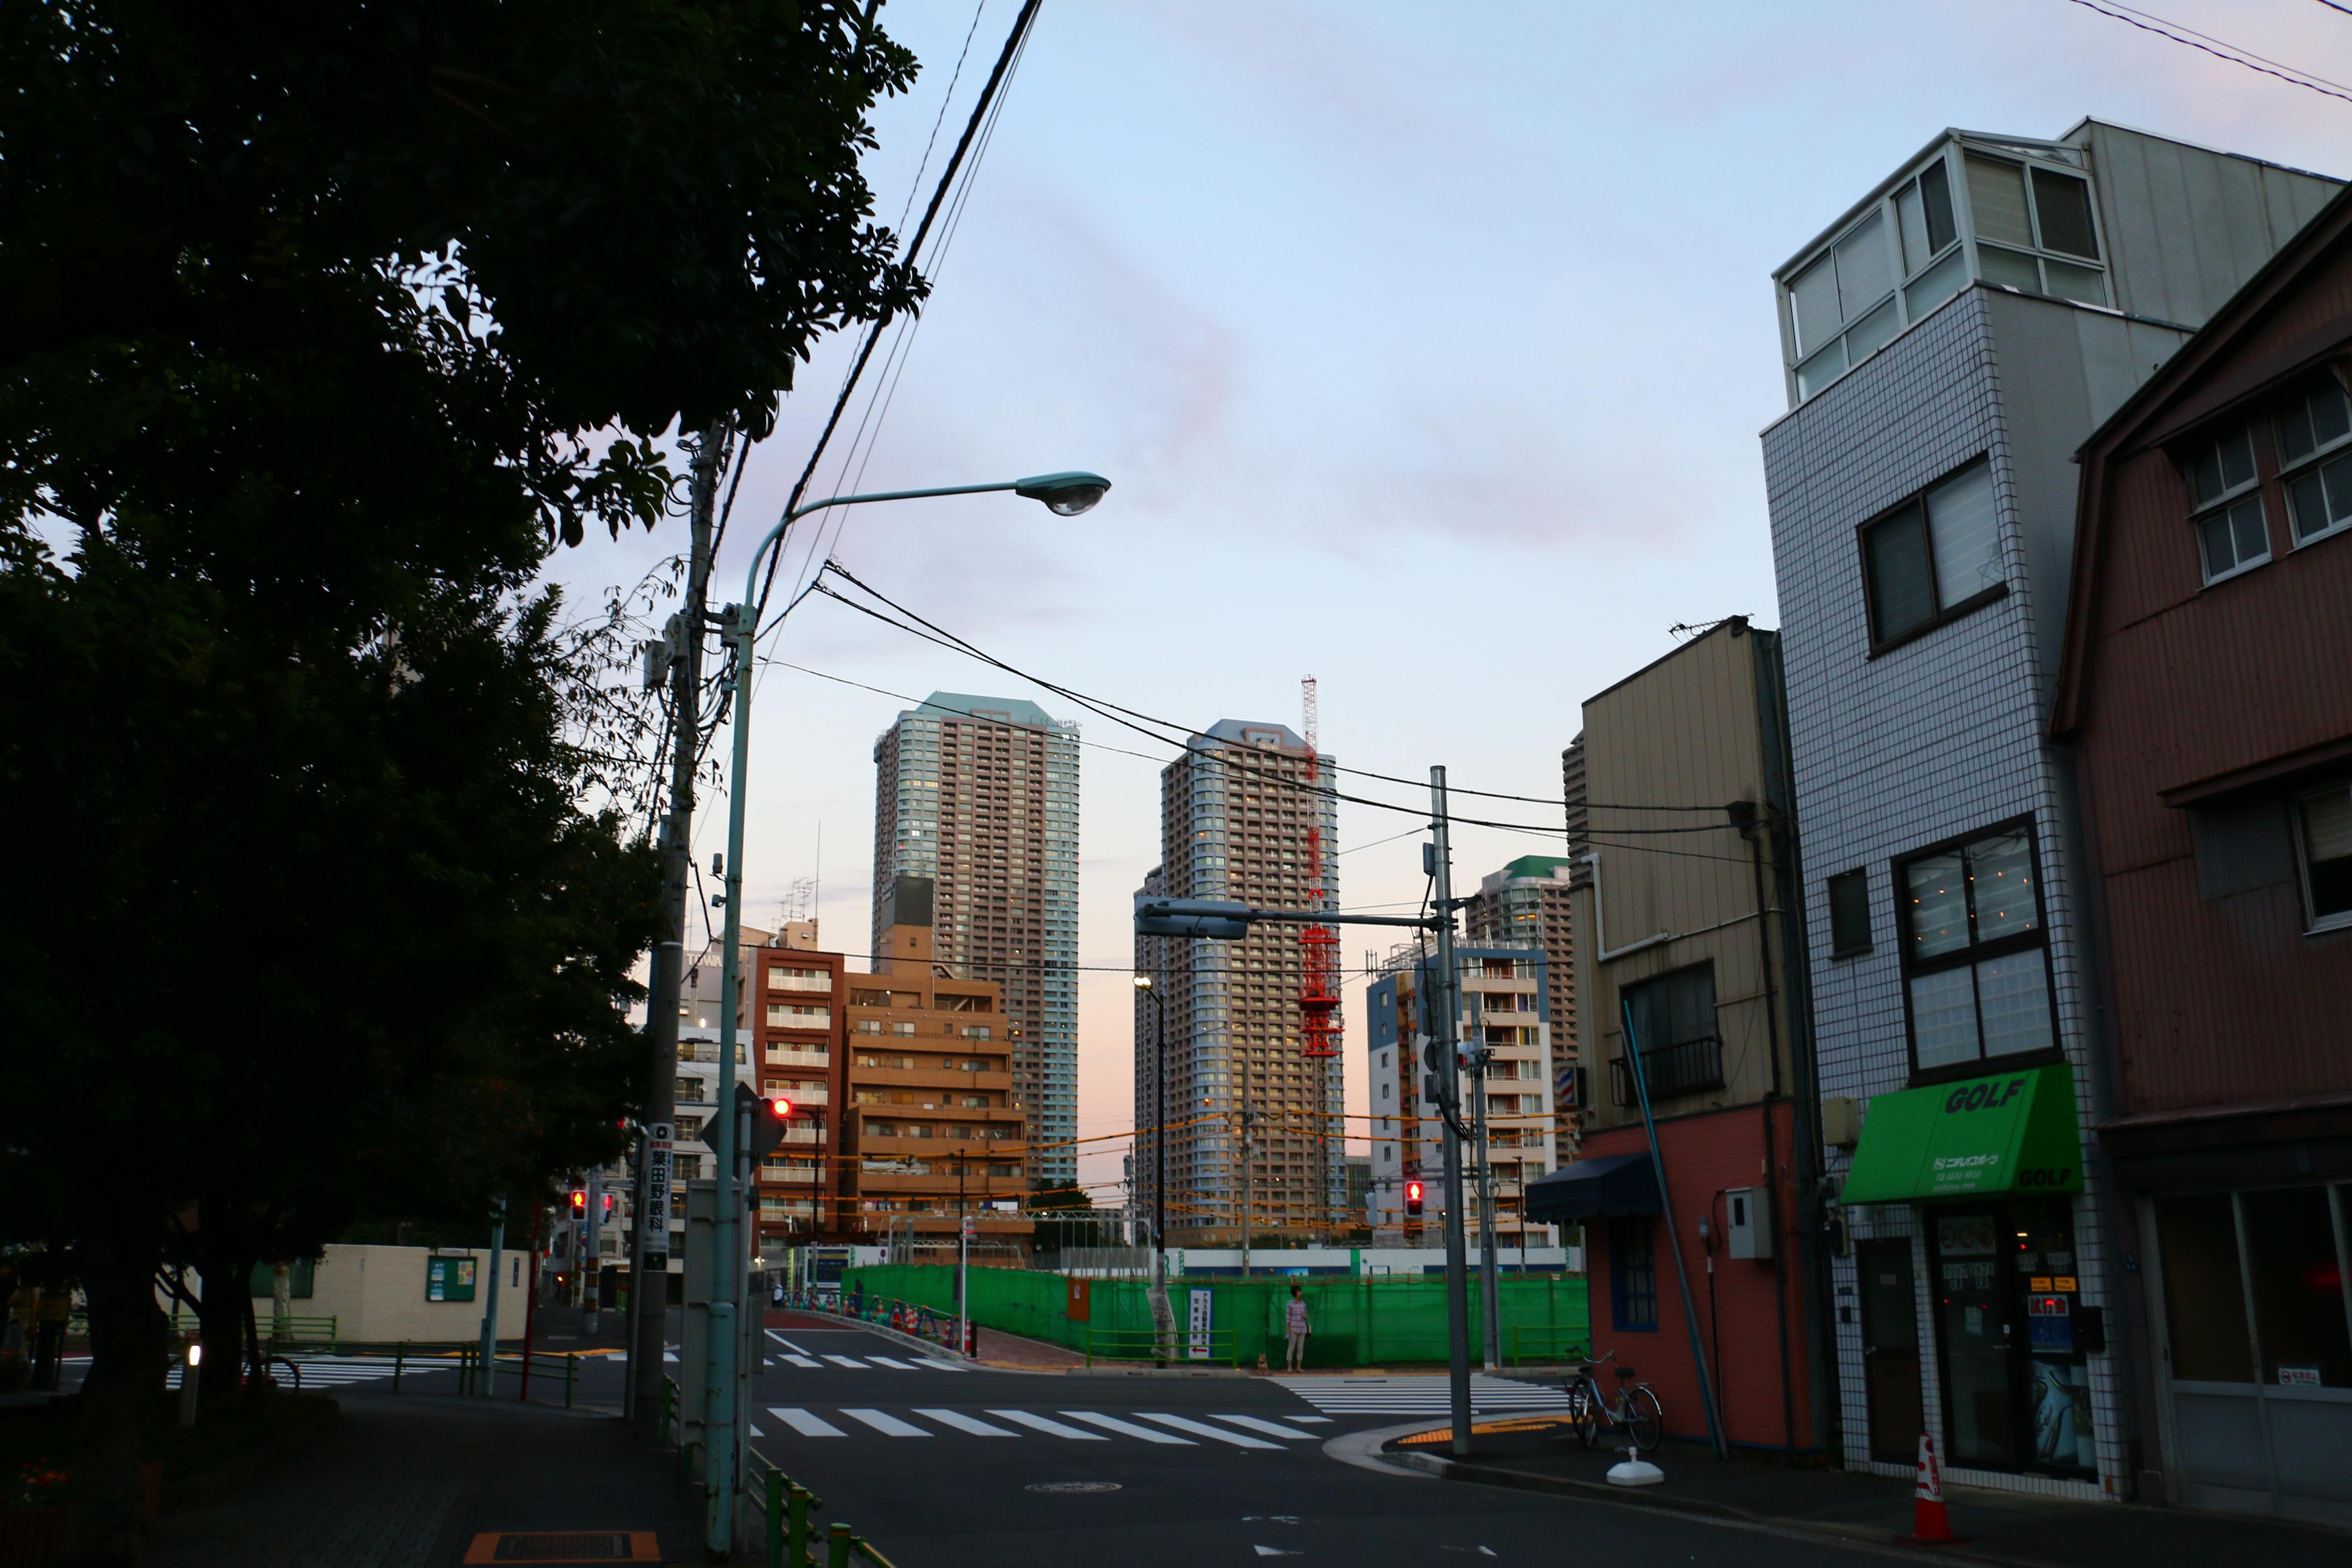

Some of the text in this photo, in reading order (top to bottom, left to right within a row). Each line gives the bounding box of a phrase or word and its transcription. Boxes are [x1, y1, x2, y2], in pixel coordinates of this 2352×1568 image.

[1946, 1080, 2025, 1113] GOLF
[2020, 1168, 2071, 1186] GOLF
[649, 1150, 666, 1232] 葉田野眼科
[2030, 1297, 2067, 1314] 試打会
